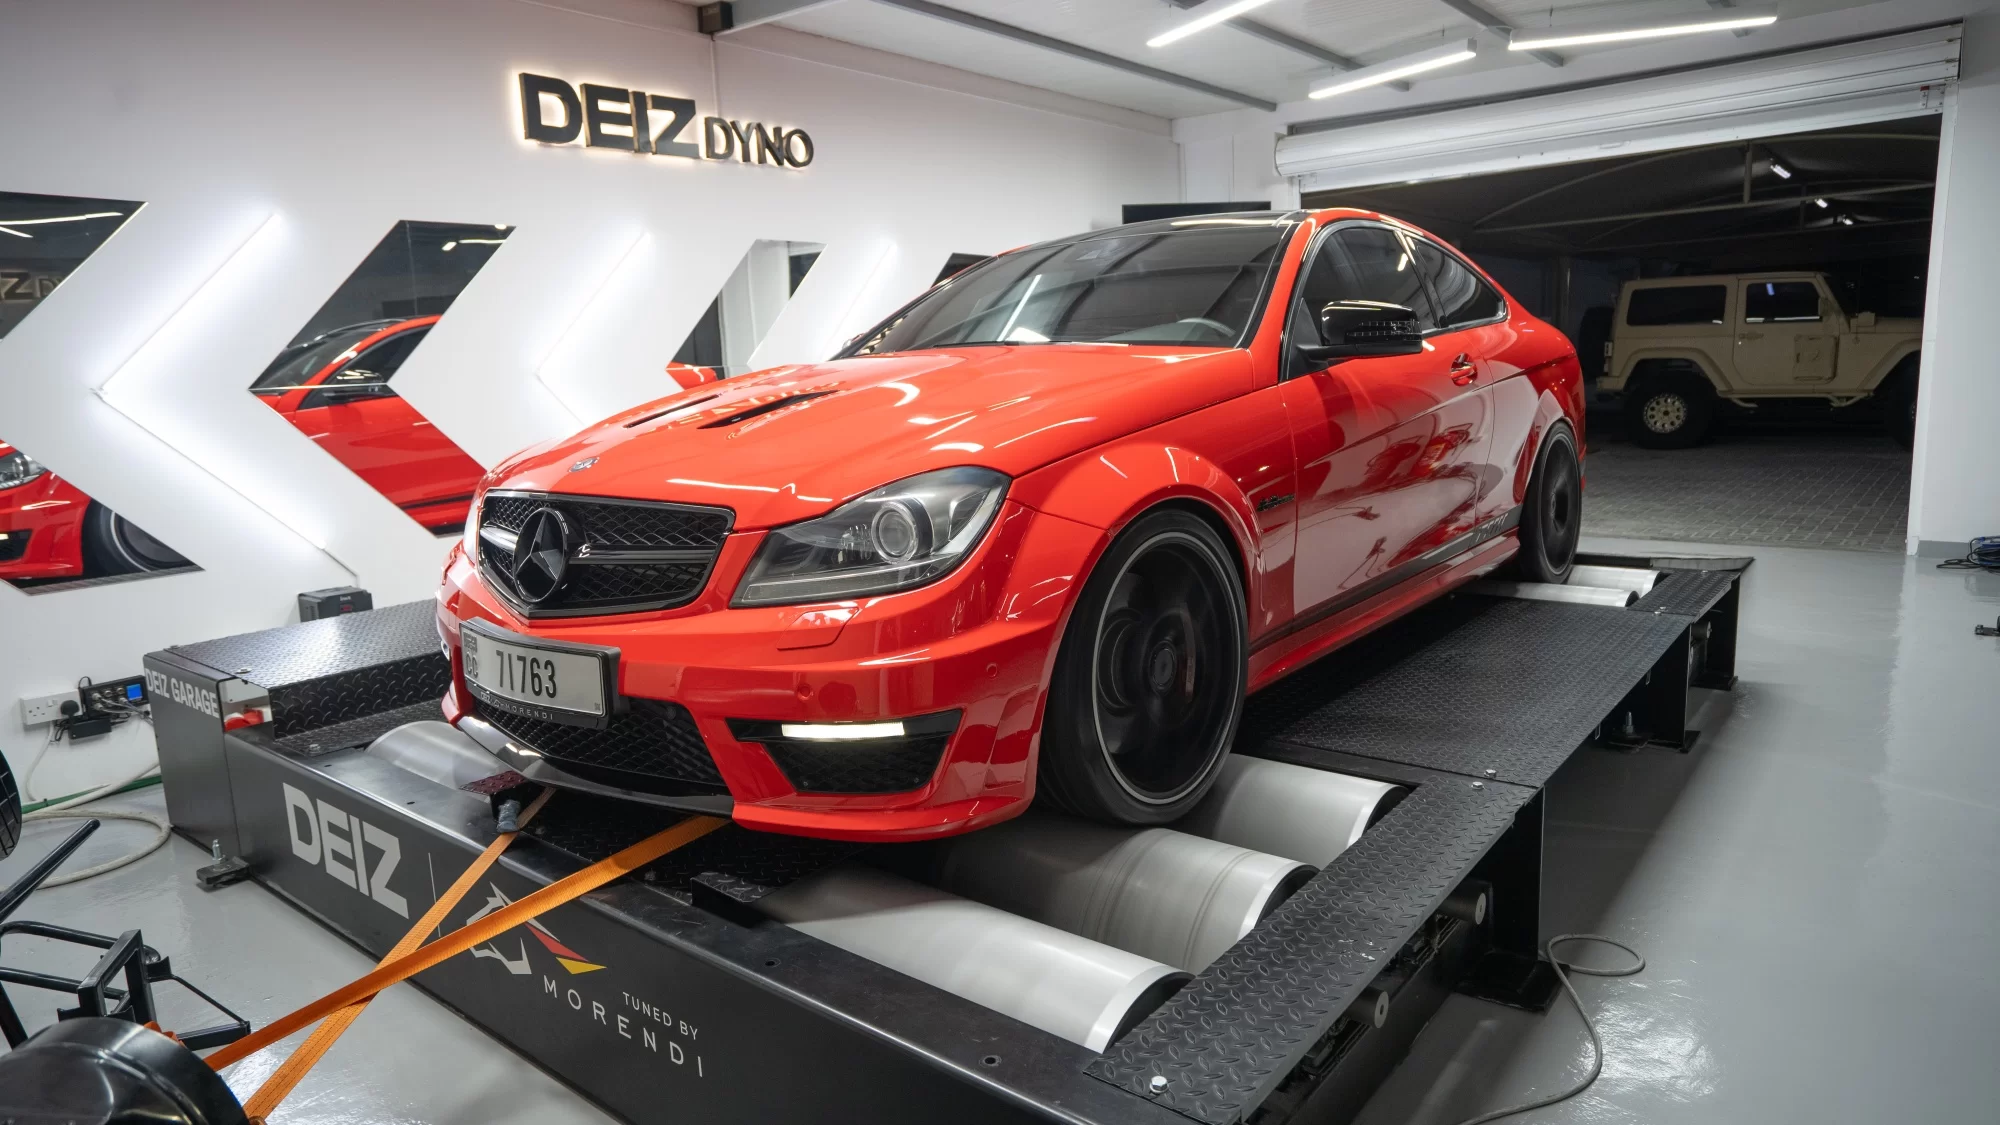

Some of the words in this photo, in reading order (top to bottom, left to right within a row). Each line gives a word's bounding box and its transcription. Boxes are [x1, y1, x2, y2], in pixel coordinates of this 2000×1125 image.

[519, 73, 699, 159] DEIZ
[704, 115, 814, 168] DYNO
[144, 668, 170, 699] DEIZ
[170, 678, 220, 719] GARAGE
[496, 650, 557, 699] 71763
[505, 703, 553, 720] MORENDI
[283, 782, 410, 920] DEIZ
[543, 974, 703, 1078] MORENDI
[622, 991, 672, 1027] TUNED
[679, 1020, 698, 1040] BY
